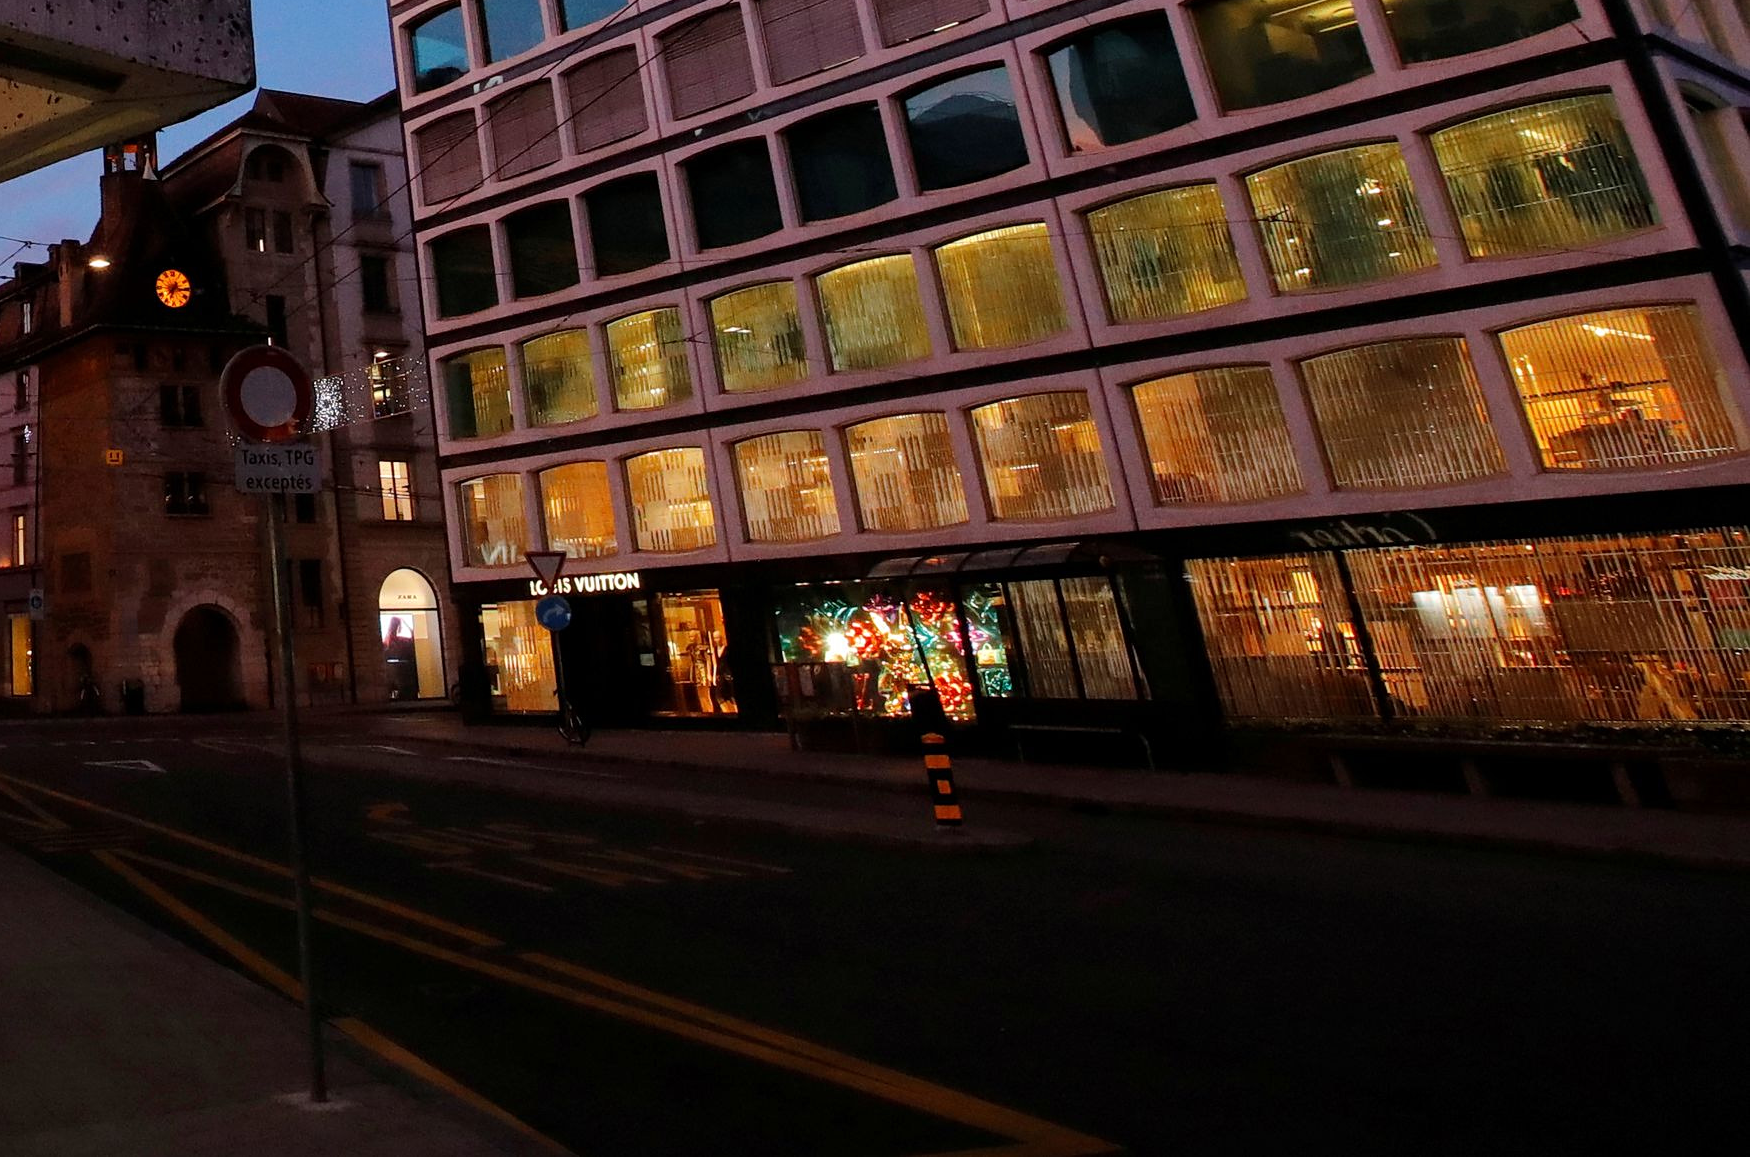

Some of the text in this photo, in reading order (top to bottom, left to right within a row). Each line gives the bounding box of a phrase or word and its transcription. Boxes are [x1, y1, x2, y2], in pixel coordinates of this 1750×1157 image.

[241, 449, 314, 466] Taxis, TPG
[246, 474, 313, 493] exceptés
[574, 572, 640, 594] VUITTON
